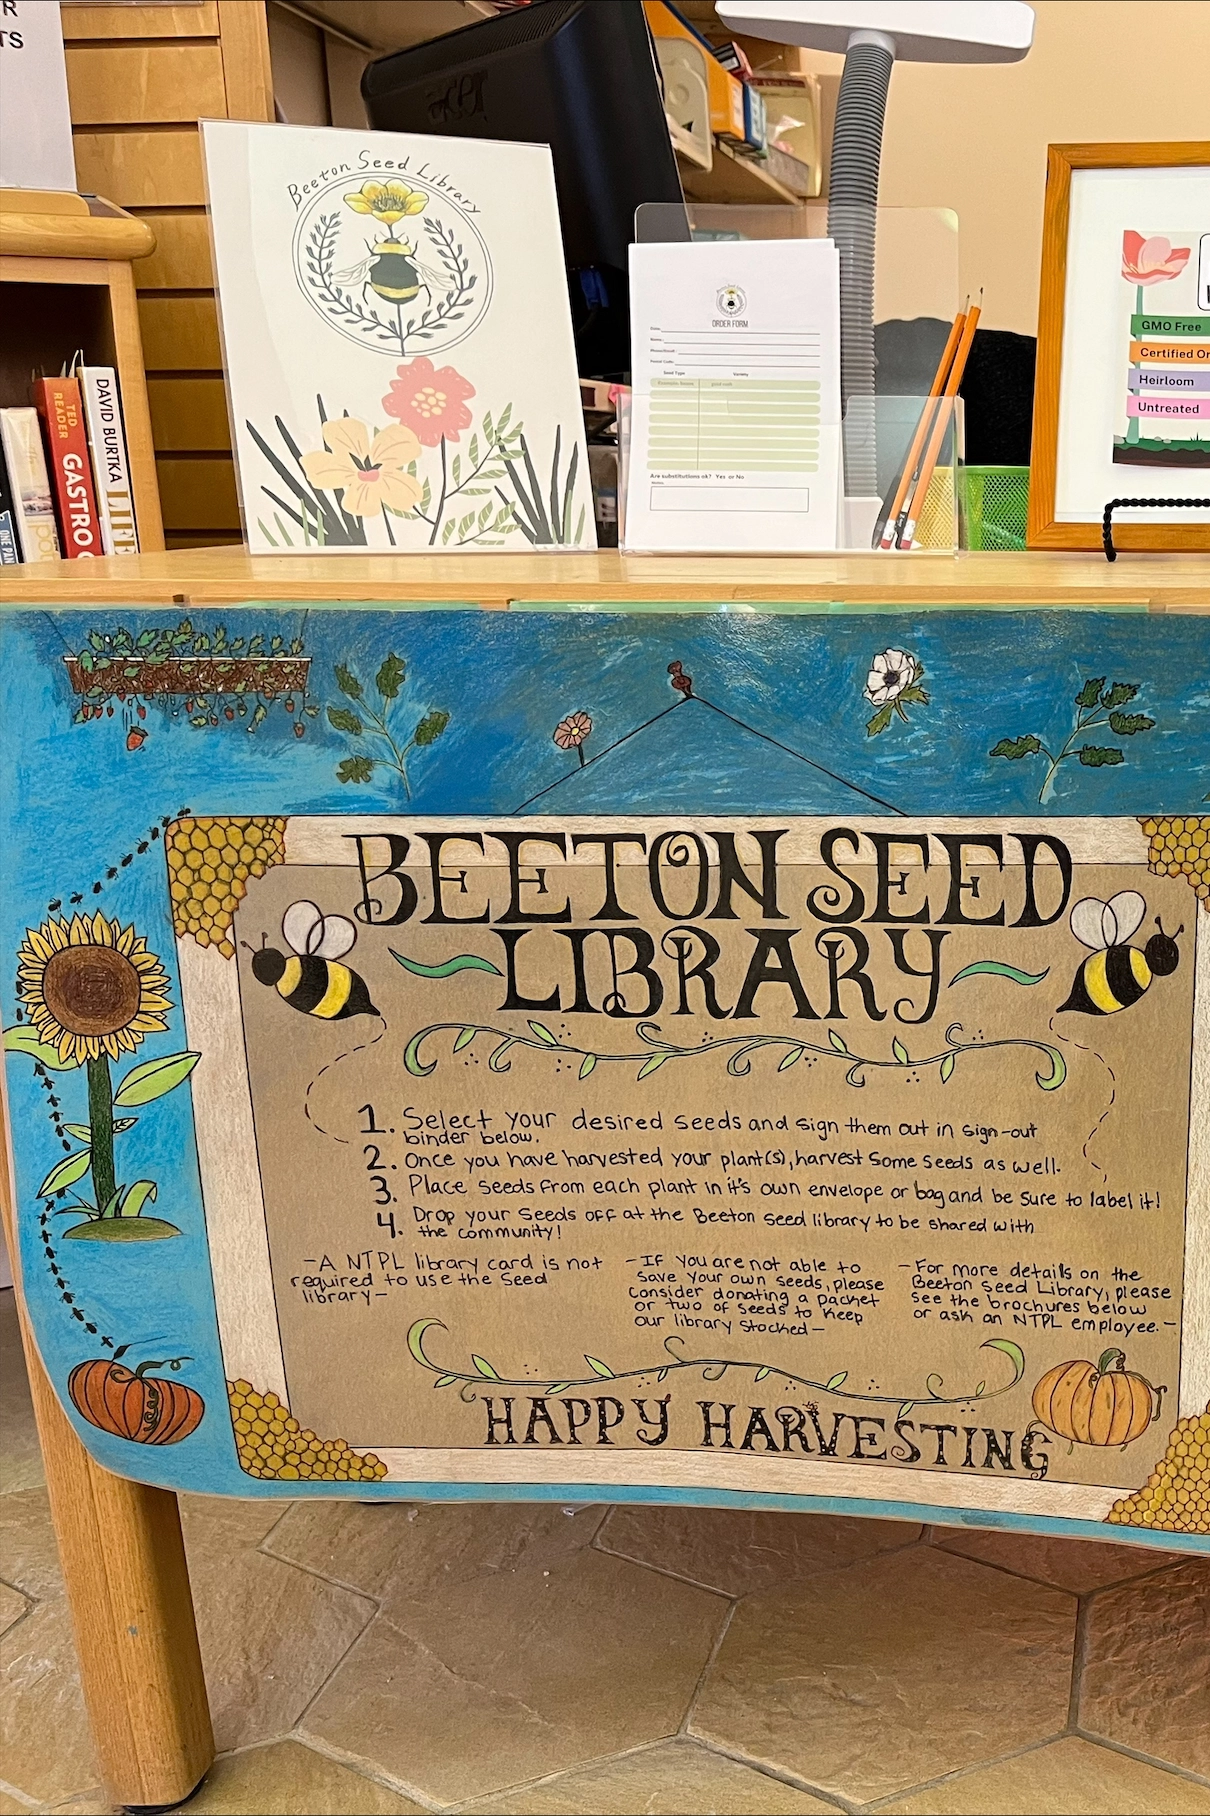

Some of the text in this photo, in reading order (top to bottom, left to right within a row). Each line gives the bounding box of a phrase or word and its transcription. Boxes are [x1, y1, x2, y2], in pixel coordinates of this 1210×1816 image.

[286, 149, 481, 214] Beeton Seed Library
[711, 319, 749, 328] ORDER FORM
[1141, 320, 1202, 332] GMO Free
[1140, 347, 1194, 359] Certified
[1139, 374, 1195, 387] Heirloom
[53, 392, 68, 439] READER
[66, 404, 78, 427] TED
[1138, 402, 1200, 414] Untreated
[96, 379, 123, 483] DAVID BURTKA
[62, 453, 93, 547] GASTRO
[341, 827, 1073, 928] BEETON SEED
[488, 925, 951, 1024] LIBRARY
[358, 1103, 396, 1134] 1.
[403, 1107, 493, 1130] Select
[505, 1111, 557, 1130] your
[572, 1107, 663, 1130] desired
[749, 1115, 789, 1131] and
[795, 1117, 839, 1141] sign
[844, 1117, 892, 1136] them
[898, 1119, 929, 1136] out
[937, 1122, 954, 1138] in
[403, 1131, 540, 1146] binder below.
[363, 1144, 397, 1171] 2.
[405, 1152, 456, 1169] Once
[464, 1156, 500, 1174] you
[507, 1151, 559, 1168] have
[561, 1146, 663, 1168] harvested
[671, 1151, 712, 1168] your
[795, 1149, 863, 1166] harvest
[983, 1158, 1006, 1171] as
[1012, 1156, 1061, 1175] well.
[370, 1175, 398, 1205] 3.
[408, 1173, 468, 1197] Place
[539, 1178, 585, 1194] from
[593, 1177, 640, 1194] each
[648, 1178, 698, 1200] plant
[705, 1181, 722, 1195] in
[727, 1176, 751, 1195] it's
[760, 1181, 801, 1196] own
[807, 1184, 884, 1203] envelope
[890, 1187, 909, 1199] or
[913, 1180, 946, 1209] bag
[948, 1186, 983, 1203] and
[992, 1188, 1014, 1204] be
[1066, 1192, 1083, 1207] to
[1090, 1190, 1133, 1209] label
[1139, 1191, 1161, 1211] it!
[377, 1212, 404, 1239] 4.
[413, 1206, 455, 1226] Drop
[465, 1209, 511, 1227] your
[623, 1206, 645, 1220] at
[650, 1207, 684, 1222] the
[692, 1207, 755, 1224] Beeton
[812, 1212, 871, 1232] library
[875, 1213, 894, 1228] to
[898, 1215, 920, 1229] be
[928, 1217, 988, 1232] shared
[993, 1218, 1034, 1234] with
[417, 1224, 562, 1241] the community!
[346, 1250, 405, 1270] NTPL
[414, 1252, 478, 1275] library
[487, 1253, 533, 1270] card
[542, 1254, 560, 1270] is
[566, 1256, 603, 1270] not
[290, 1272, 373, 1293] required
[384, 1273, 408, 1286] to
[416, 1273, 453, 1287] use
[458, 1272, 492, 1286] the
[480, 1395, 1053, 1481] HAPPY HARVESTING
